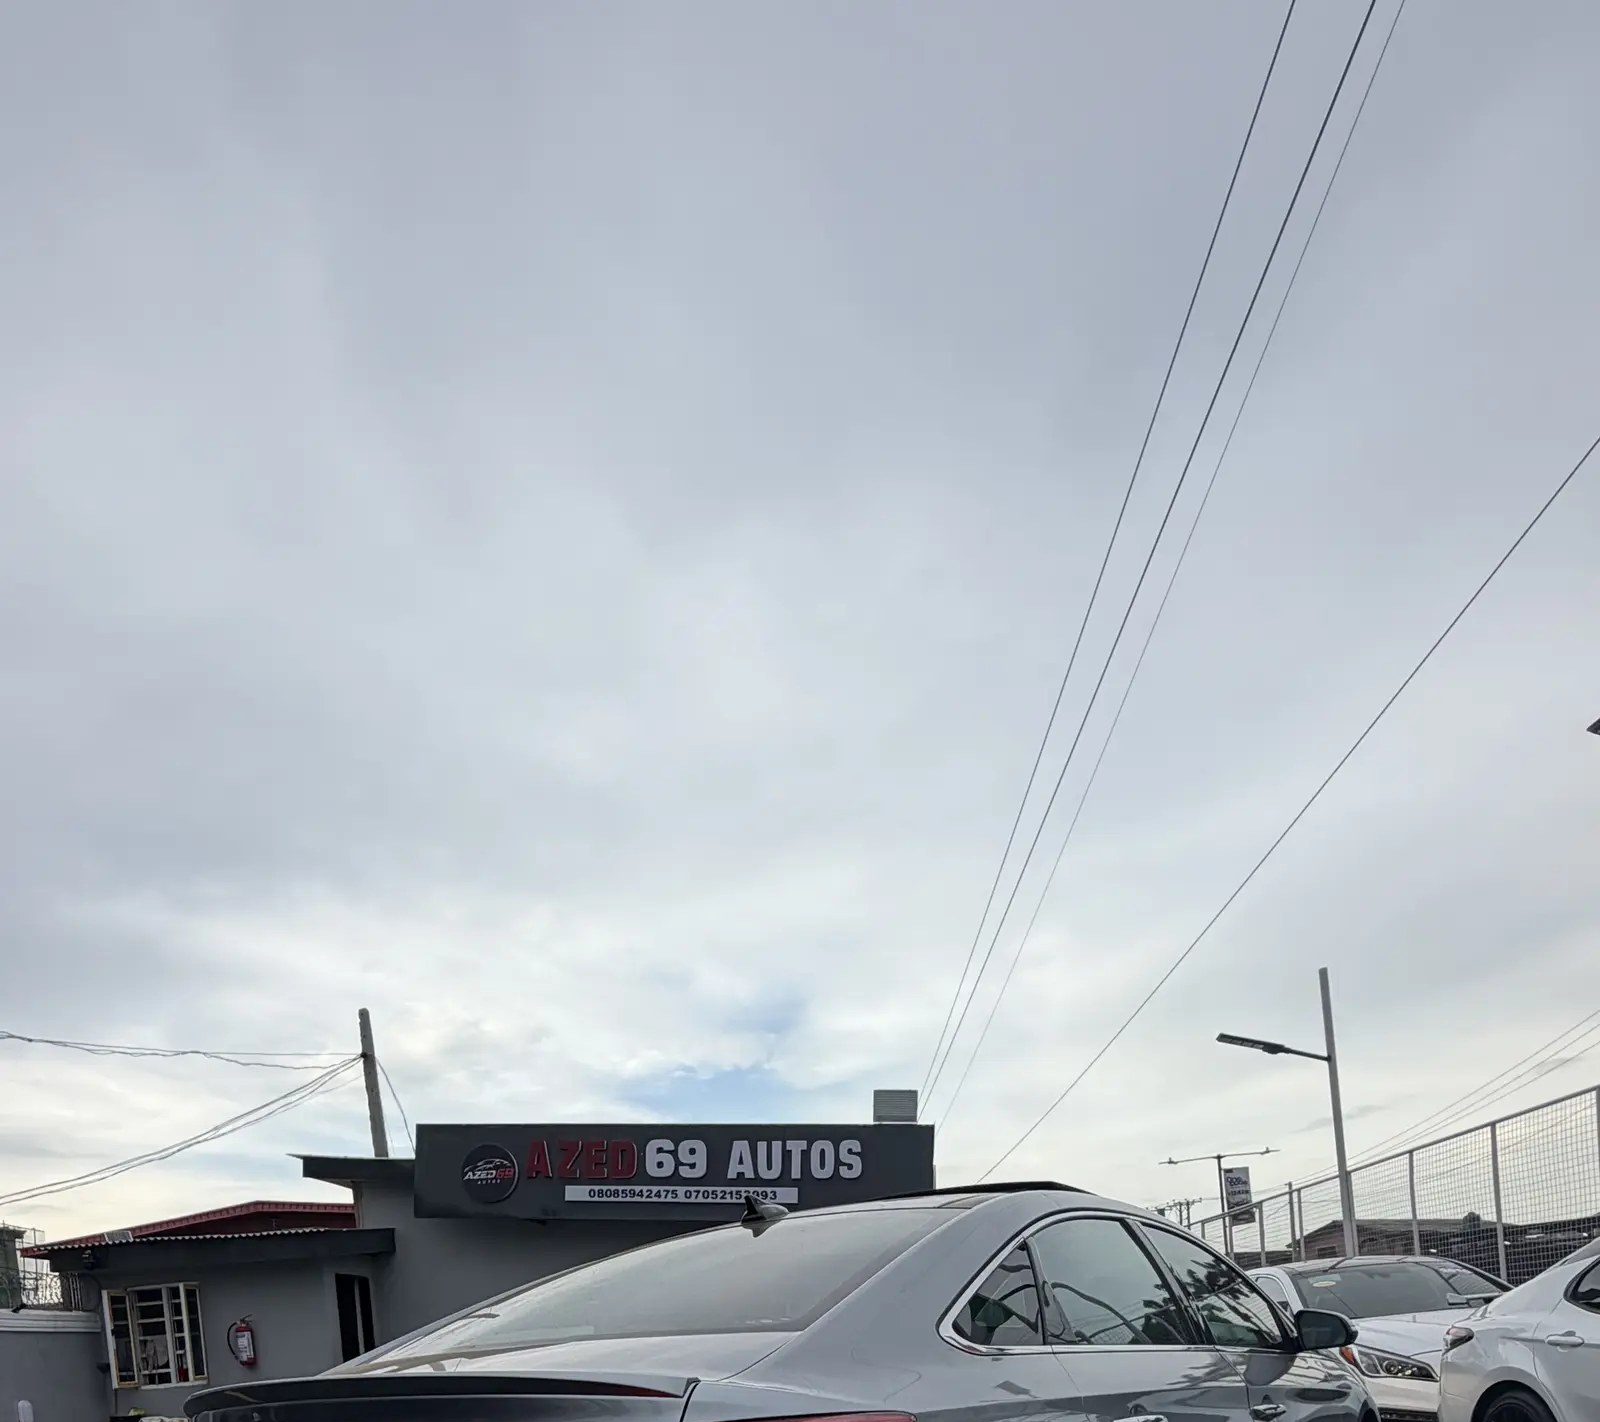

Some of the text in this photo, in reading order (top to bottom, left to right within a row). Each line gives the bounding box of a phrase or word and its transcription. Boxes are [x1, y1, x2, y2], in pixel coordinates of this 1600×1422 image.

[526, 1139, 863, 1181] AZED 69 AUTOS
[588, 1188, 679, 1199] 08085942475
